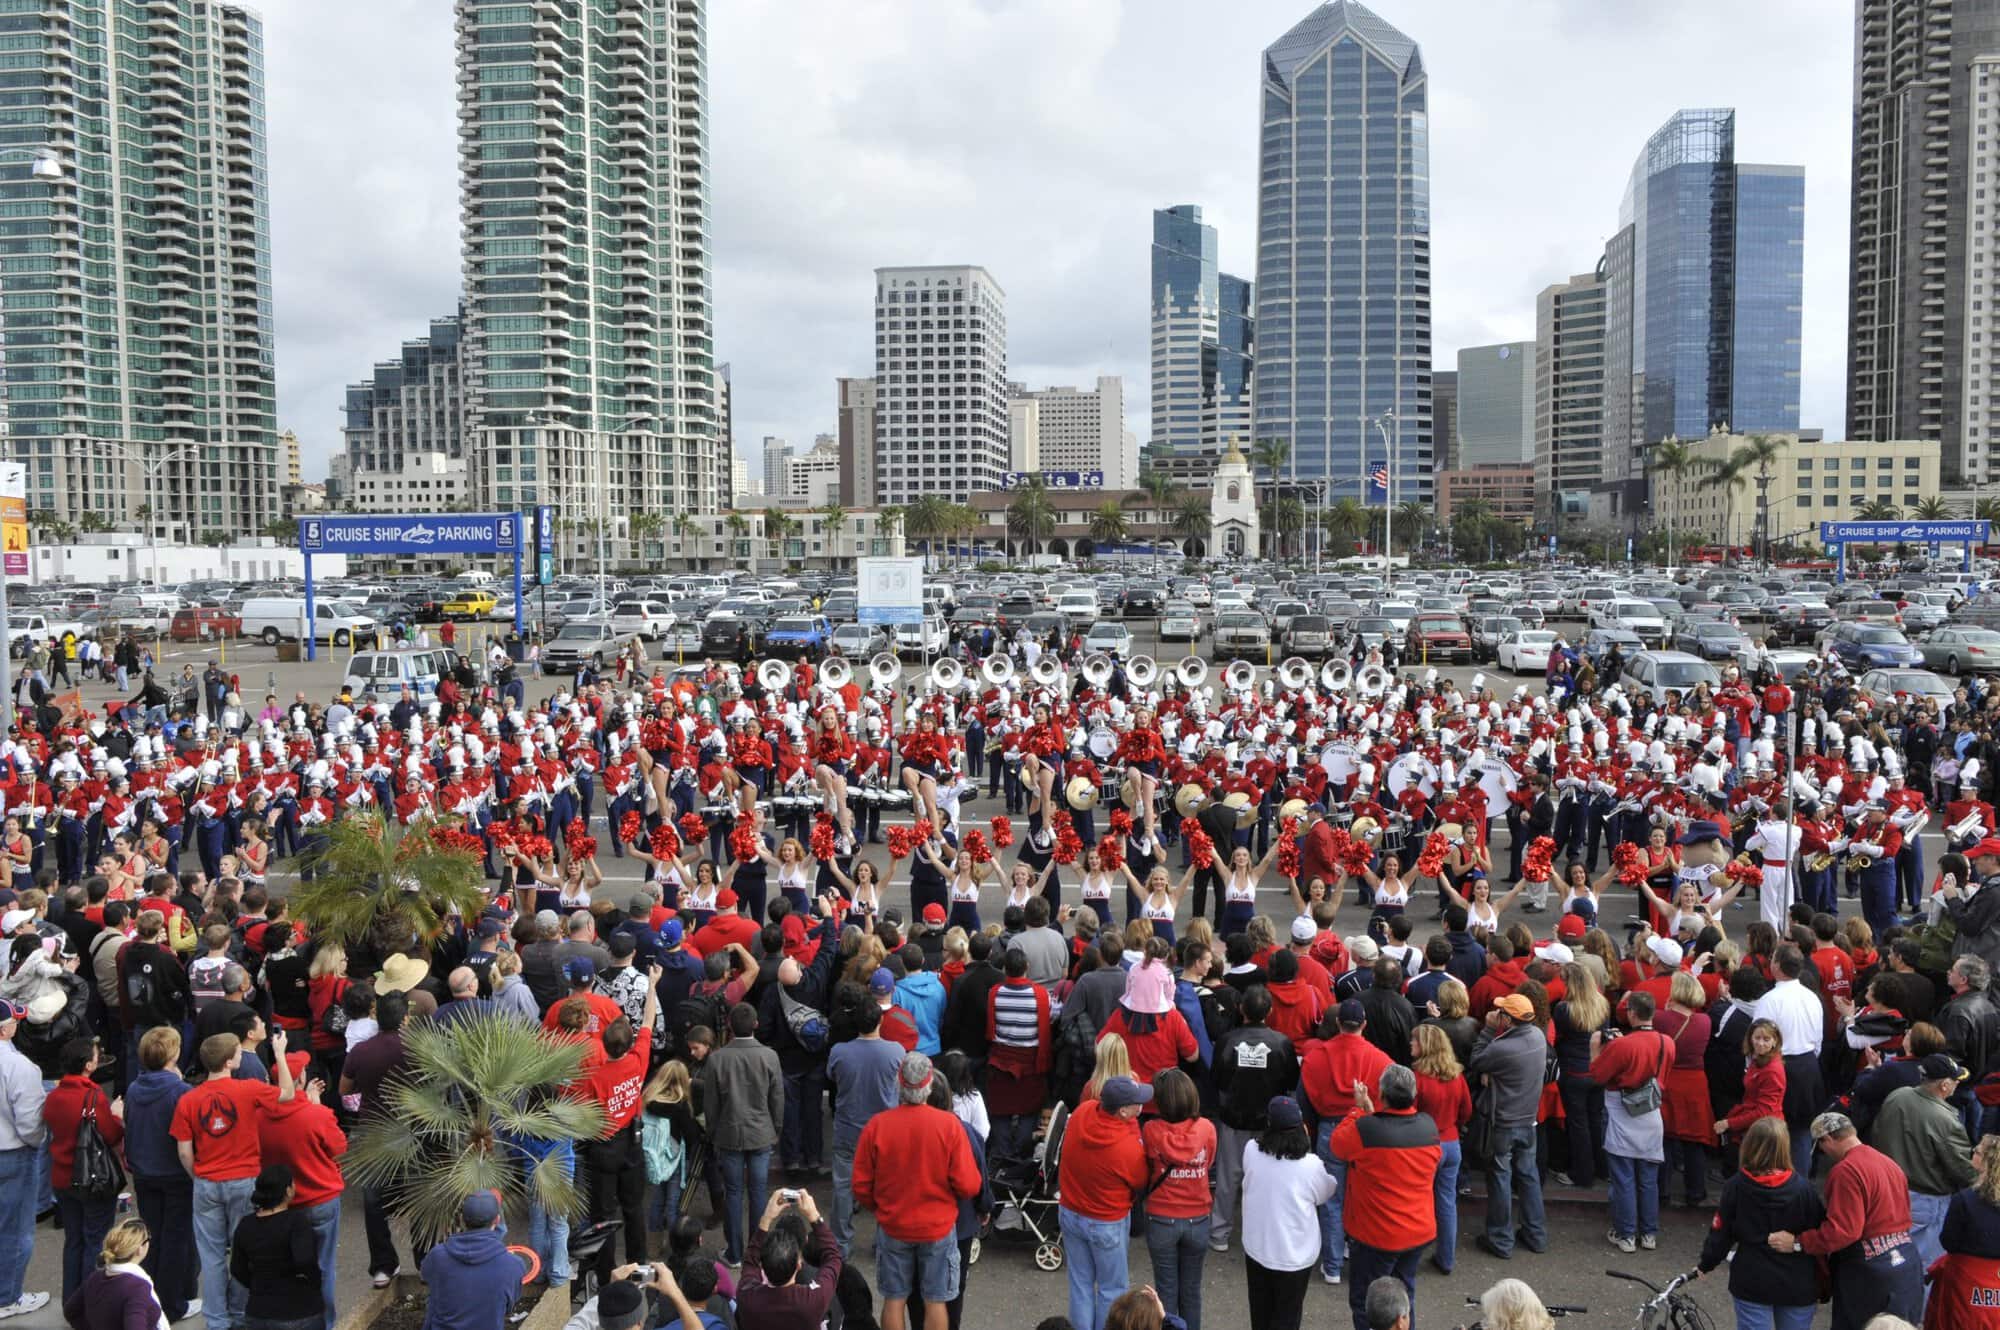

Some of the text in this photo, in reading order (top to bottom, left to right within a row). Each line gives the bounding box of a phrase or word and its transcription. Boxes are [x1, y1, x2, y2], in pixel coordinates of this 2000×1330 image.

[1078, 472, 1100, 486] Fe
[500, 520, 511, 537] 5
[541, 508, 550, 537] 5
[308, 523, 319, 539] 5
[326, 526, 493, 542] CRUISE SHIP PARKING
[1838, 526, 1971, 536] CRUISE SHIP PARKING
[1829, 545, 1838, 555] P
[543, 559, 550, 580] P
[613, 1075, 640, 1095] DON'T
[607, 1094, 625, 1107] TELL
[609, 1103, 622, 1113] SIT
